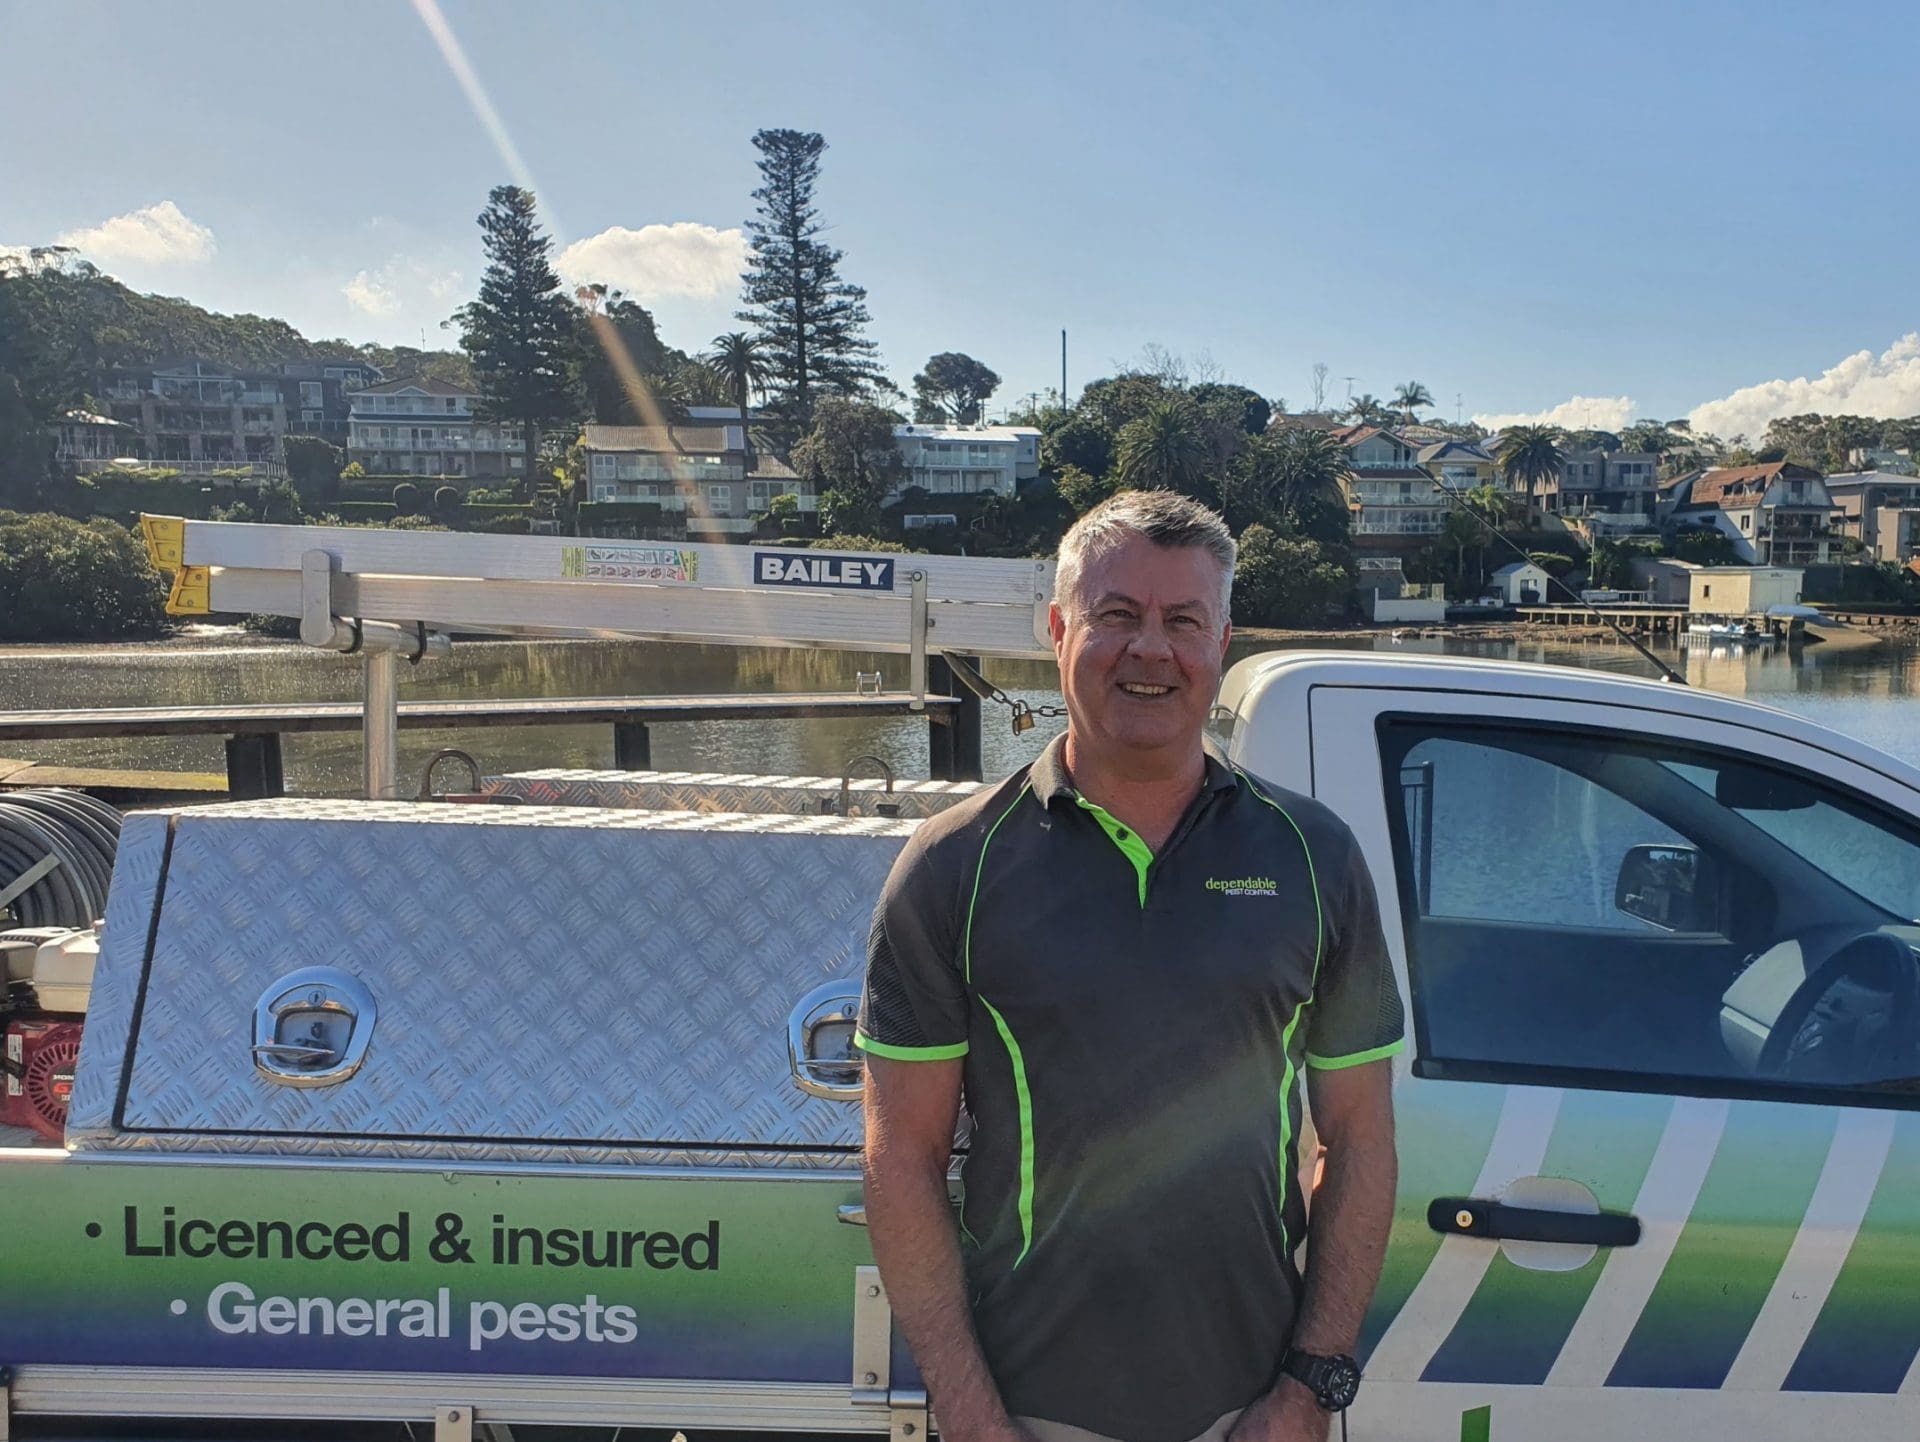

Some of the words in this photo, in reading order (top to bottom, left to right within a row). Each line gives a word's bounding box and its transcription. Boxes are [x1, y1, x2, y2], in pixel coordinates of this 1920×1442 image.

[762, 557, 888, 585] BAILEY
[1205, 877, 1277, 891] dependable
[1225, 888, 1243, 896] PEST
[1244, 888, 1279, 896] CONTROL
[124, 1205, 410, 1262] Licenced
[428, 1212, 476, 1264] &
[492, 1214, 720, 1271] insured
[206, 1281, 450, 1339] General
[469, 1294, 638, 1351] pests
